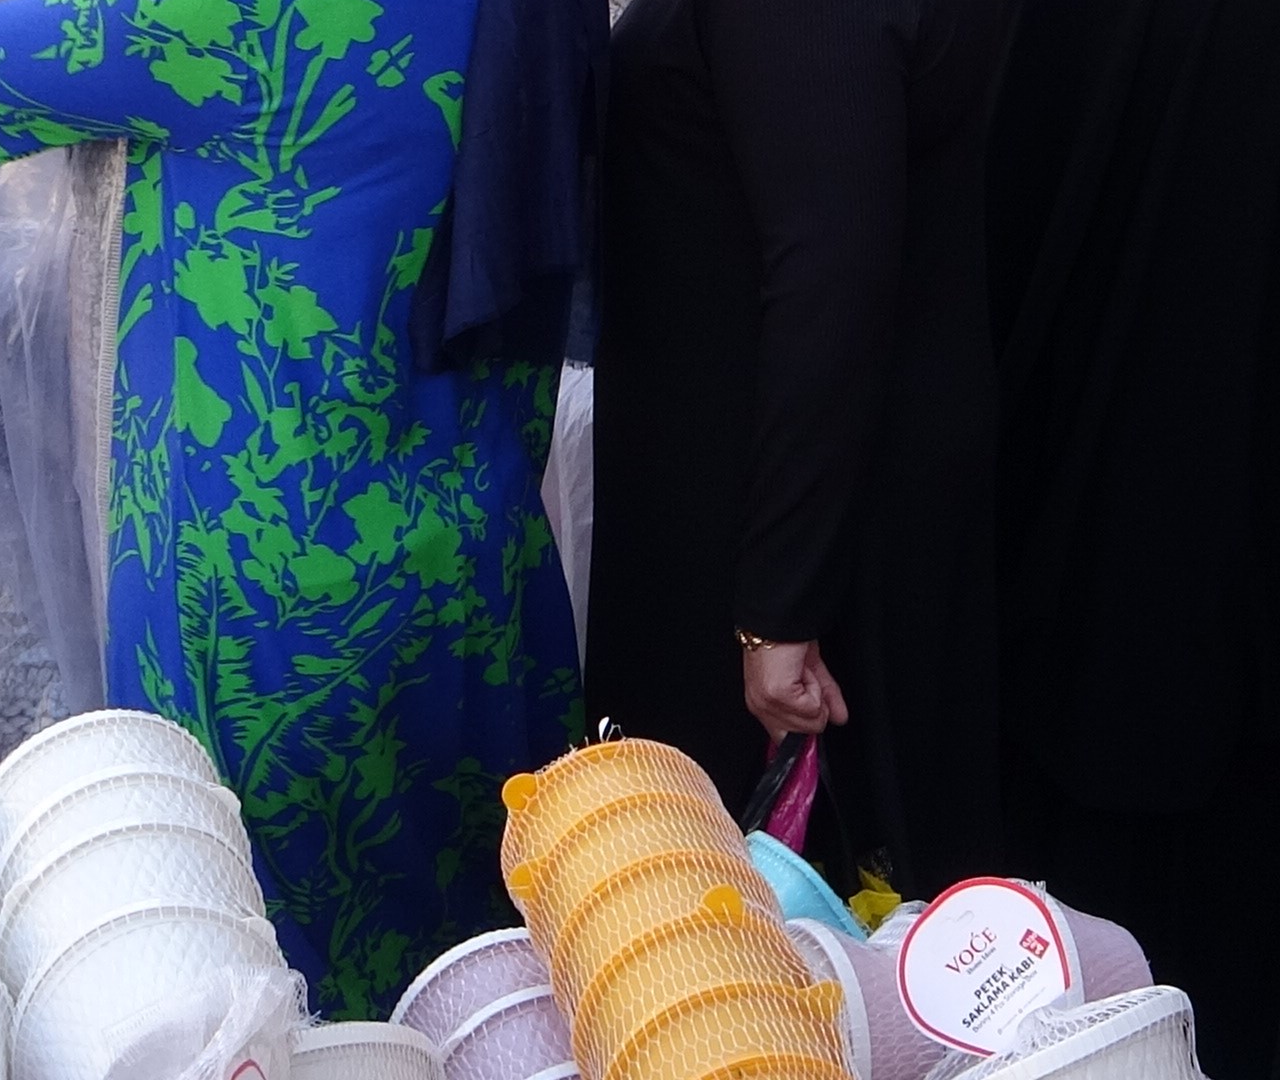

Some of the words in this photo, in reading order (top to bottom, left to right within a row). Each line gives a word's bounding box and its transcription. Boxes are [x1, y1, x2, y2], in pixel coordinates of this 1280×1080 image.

[945, 927, 997, 974] VOĆE
[962, 981, 1010, 1028] SAKLAMA
[1008, 956, 1035, 982] KABI
[974, 966, 1007, 1000] PETEK
